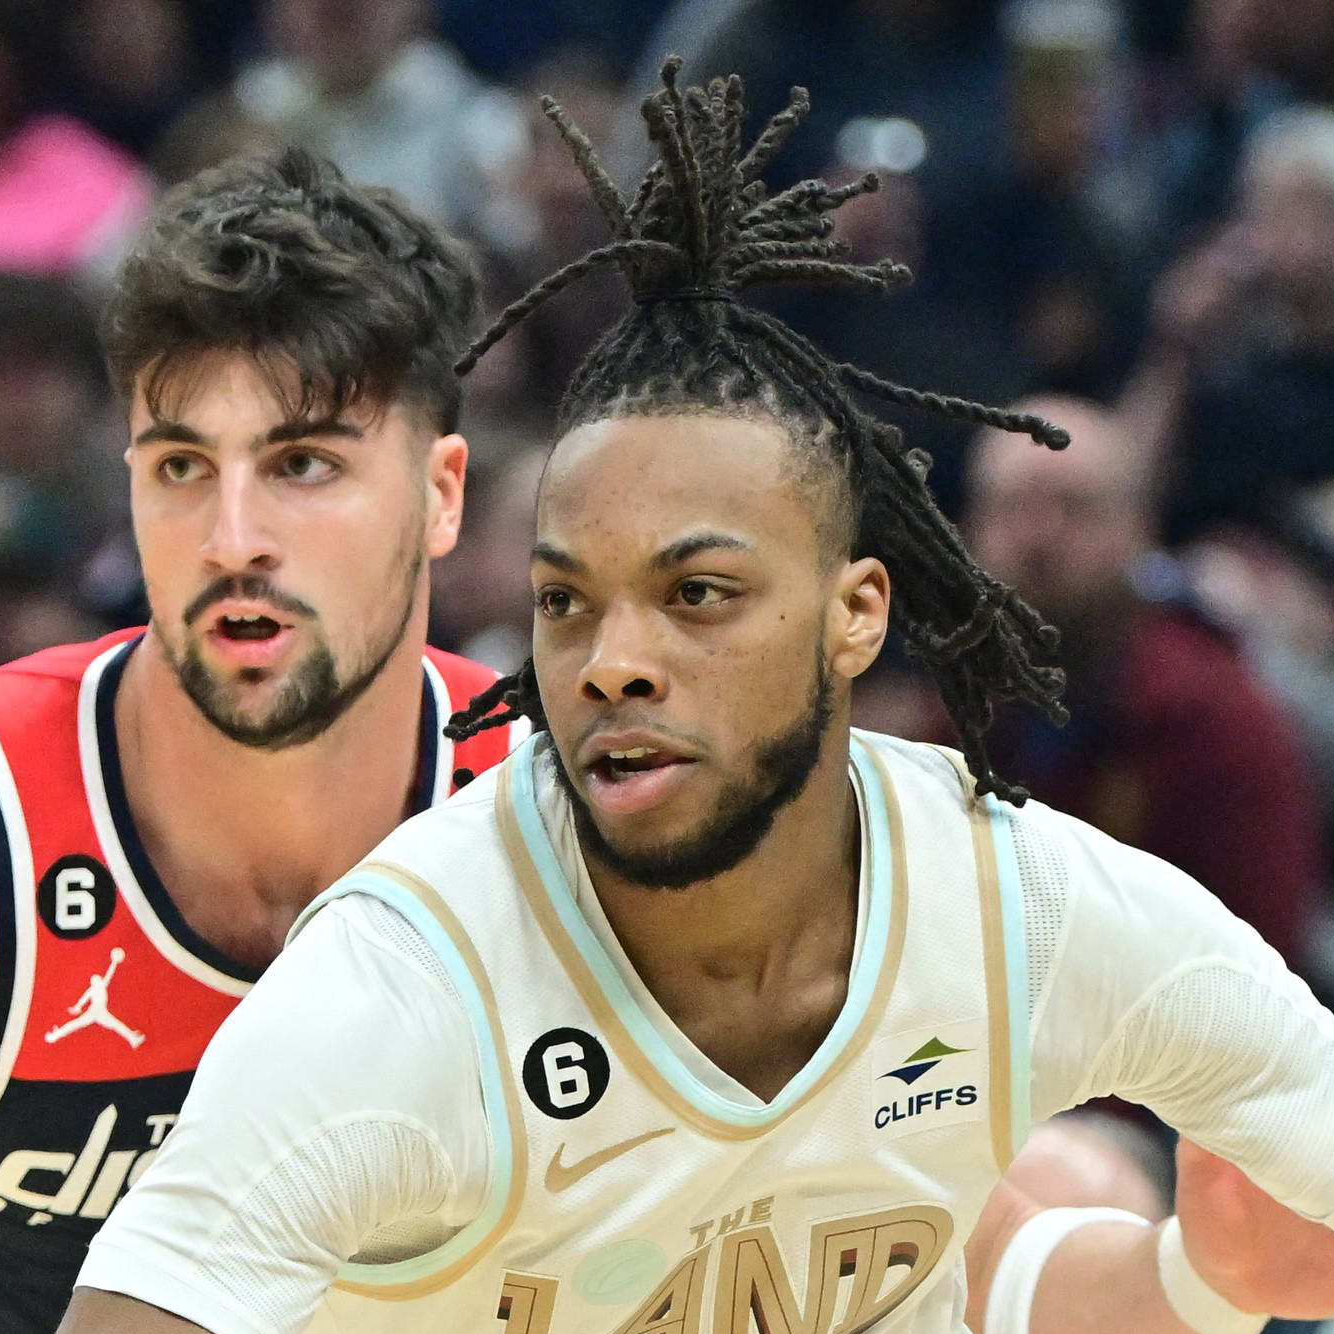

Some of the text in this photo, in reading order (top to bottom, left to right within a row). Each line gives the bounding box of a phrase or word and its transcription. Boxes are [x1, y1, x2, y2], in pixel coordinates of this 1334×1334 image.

[55, 867, 97, 929] 6
[542, 1041, 591, 1108] 6
[874, 1084, 979, 1130] CLIFFS
[688, 1195, 775, 1249] THE
